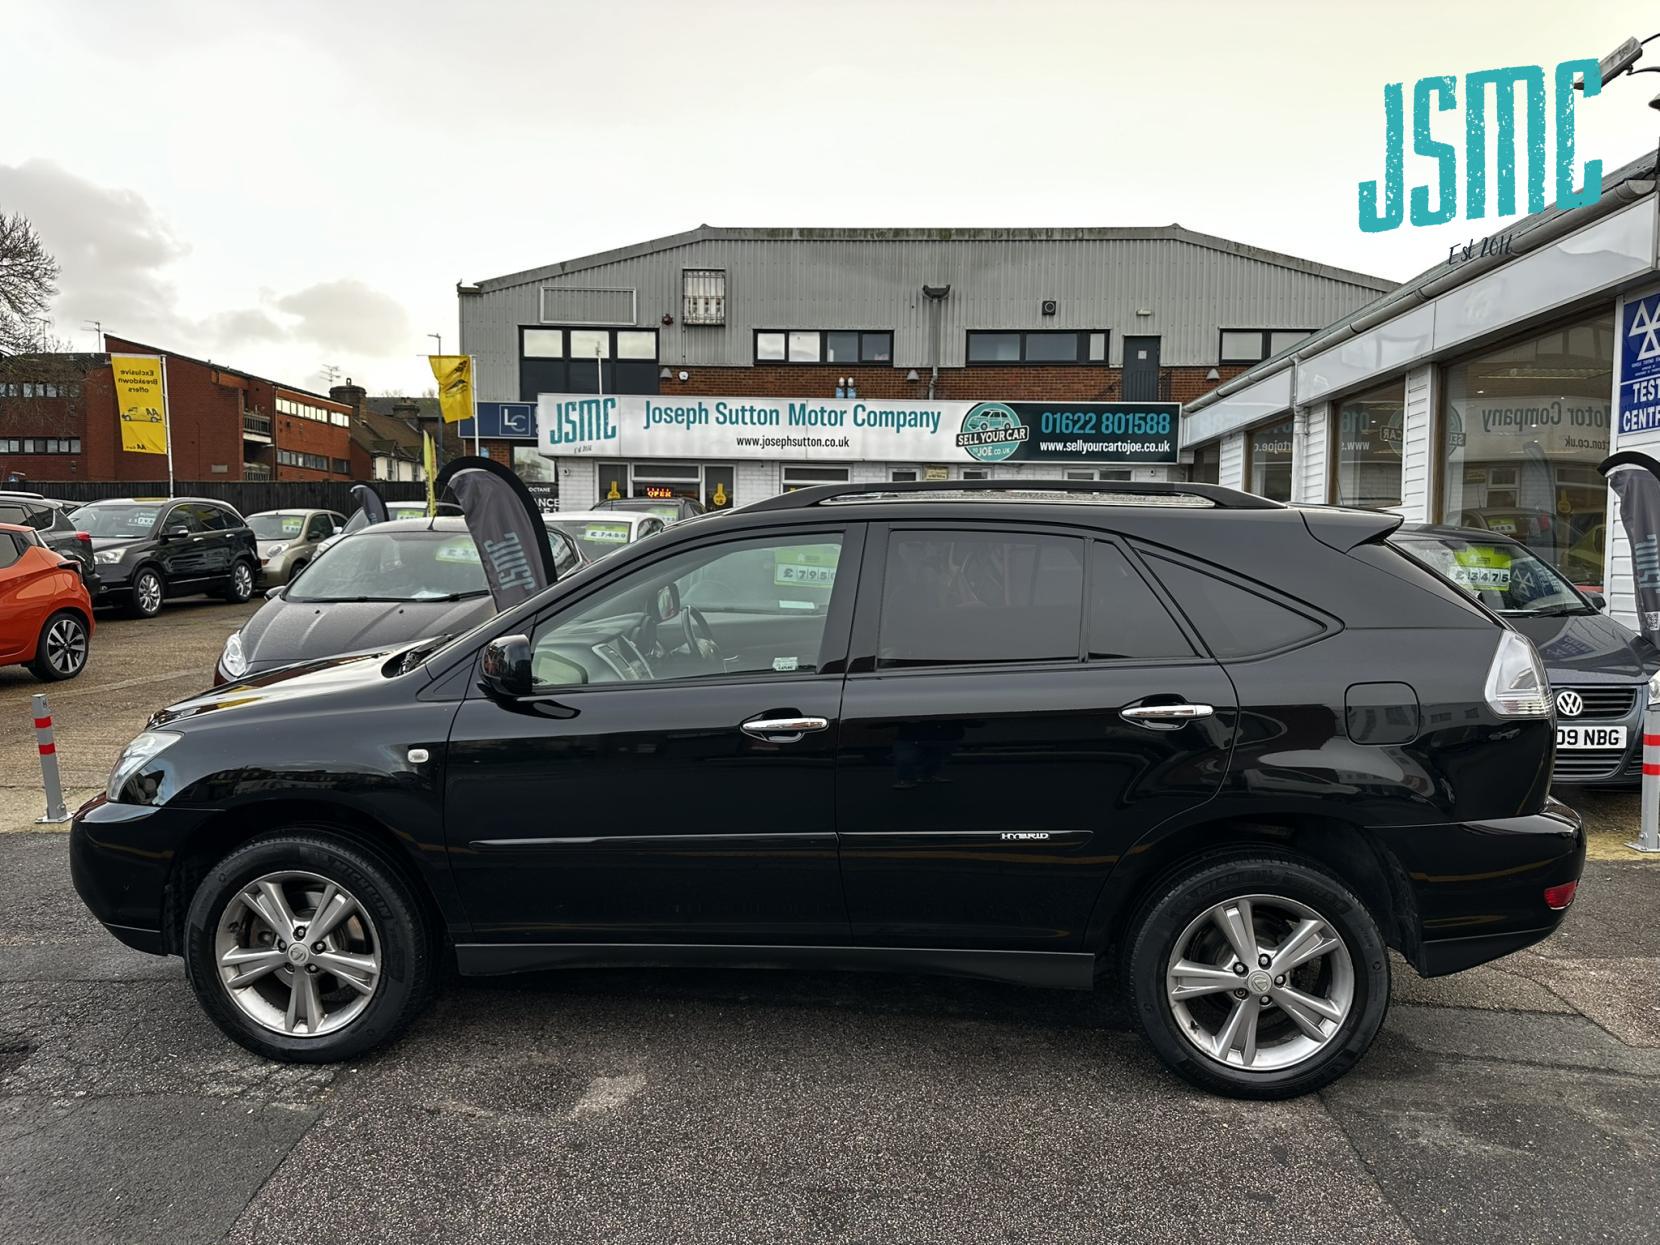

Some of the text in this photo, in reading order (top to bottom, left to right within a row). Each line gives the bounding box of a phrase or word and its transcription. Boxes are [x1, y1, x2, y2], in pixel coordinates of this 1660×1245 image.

[549, 397, 617, 445] JSMC
[643, 400, 941, 434] Joseph Sutton Motor Company
[1041, 412, 1170, 435] 01622 801588
[736, 435, 850, 449] www.josephsutton.co.uk
[958, 428, 1026, 446] SELL YOUR CAR
[1040, 439, 1170, 455] www.sellyourcartojoe.co.uk
[1583, 729, 1620, 746] NBG
[1001, 832, 1049, 840] HYBRID
